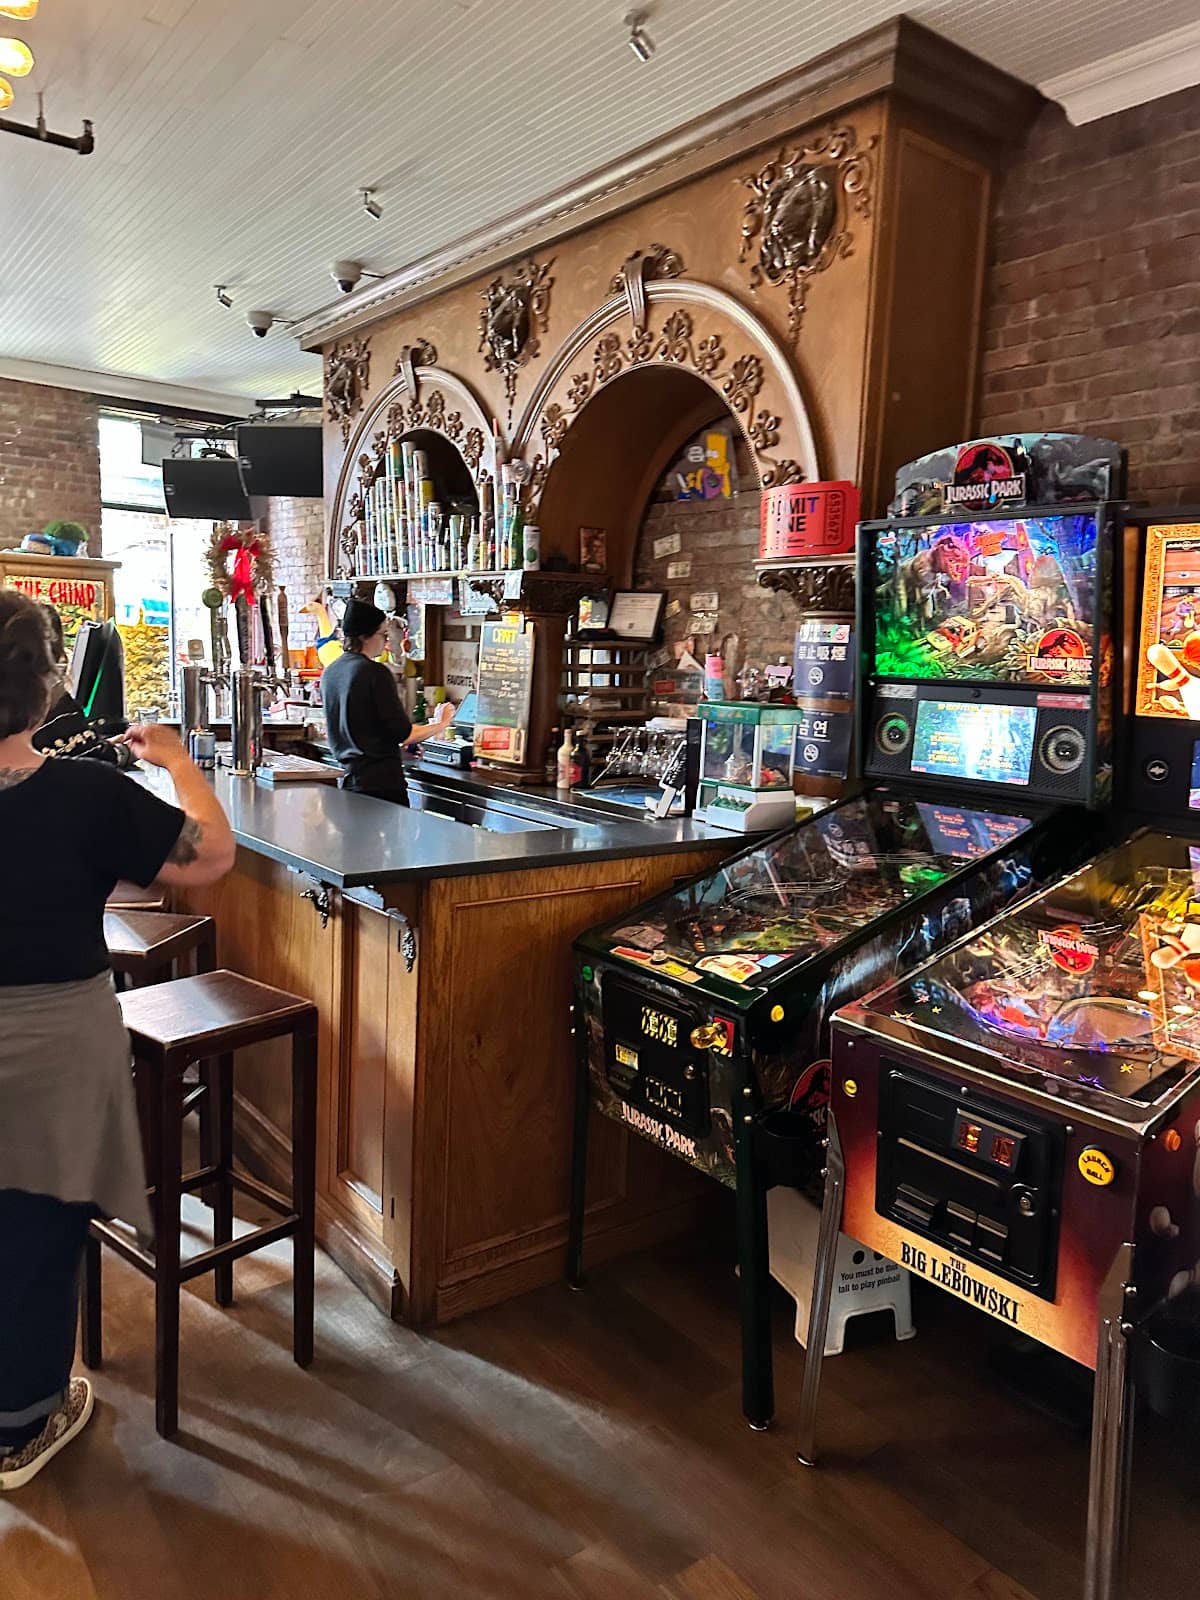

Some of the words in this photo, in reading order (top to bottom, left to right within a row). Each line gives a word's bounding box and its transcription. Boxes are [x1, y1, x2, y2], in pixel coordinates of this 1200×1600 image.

[946, 483, 990, 504] JURASSIC
[991, 480, 1021, 499] PARK
[14, 580, 42, 598] THE
[49, 582, 96, 611] CHIMP
[1031, 657, 1067, 670] JURASSIC
[1066, 657, 1092, 671] PARK
[620, 1100, 664, 1141] JURASSIC
[664, 1123, 696, 1159] PARK
[840, 1271, 855, 1281] You
[855, 1267, 875, 1278] must
[875, 1266, 885, 1275] be
[949, 1256, 967, 1274] THE
[838, 1283, 851, 1294] tall
[851, 1282, 860, 1291] to
[860, 1279, 877, 1292] play
[877, 1273, 901, 1287] pinball
[900, 1242, 928, 1275] BIG
[930, 1257, 1020, 1325] LEBOW$KI
